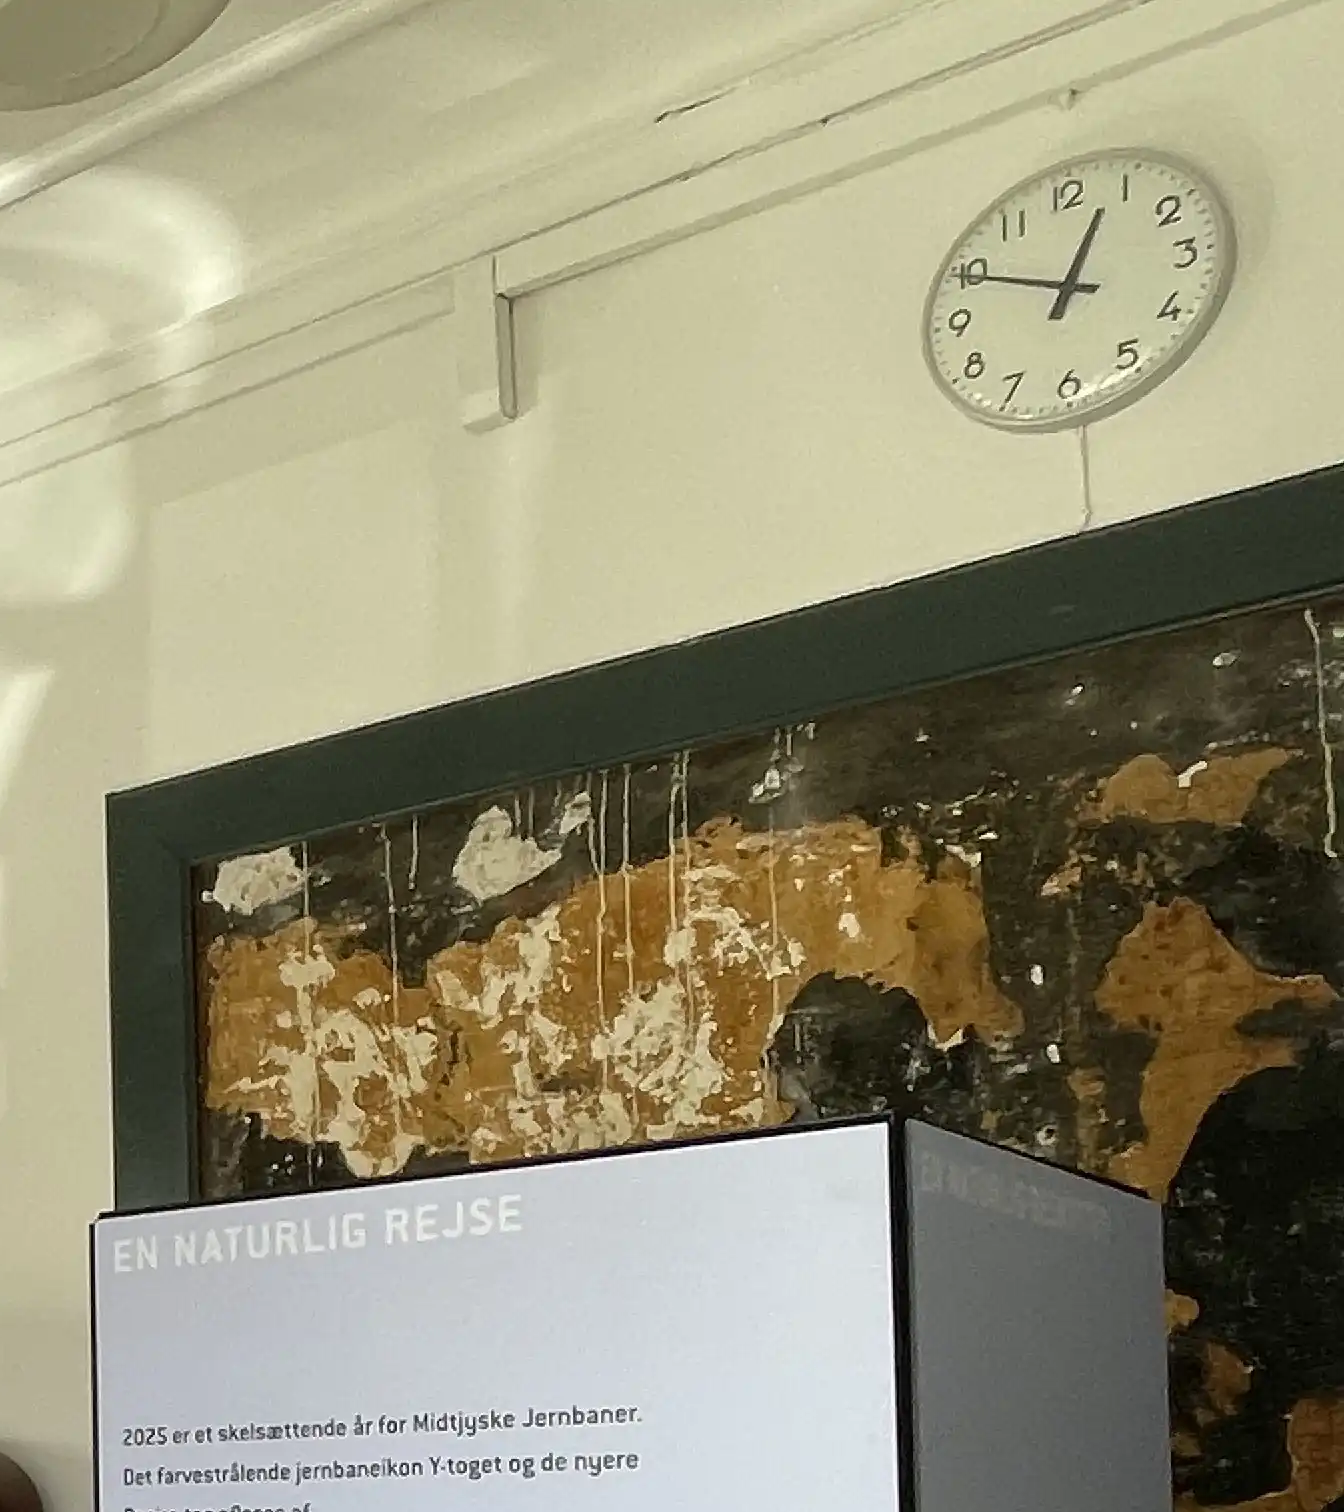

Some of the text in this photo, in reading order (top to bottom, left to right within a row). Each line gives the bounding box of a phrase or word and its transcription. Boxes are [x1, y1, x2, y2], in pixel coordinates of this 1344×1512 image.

[1053, 178, 1084, 213] 12
[1122, 173, 1129, 202] 1
[1001, 209, 1026, 242] 11
[1155, 194, 1182, 227] 2
[1173, 237, 1198, 268] 3
[959, 257, 988, 289] 10
[948, 307, 972, 337] 9
[1156, 291, 1182, 321] 4
[963, 352, 985, 379] 8
[1115, 338, 1139, 370] 5
[1001, 370, 1026, 412] 7
[1057, 369, 1081, 400] 6
[114, 1194, 523, 1274] EN NATURLIG REJSE
[123, 1405, 642, 1446] 2025 er et skelsættende år for Midtjyske Jernbaner.
[124, 1453, 639, 1486] Det farvestrålende jernbaneikon Y-toget og de nyere
